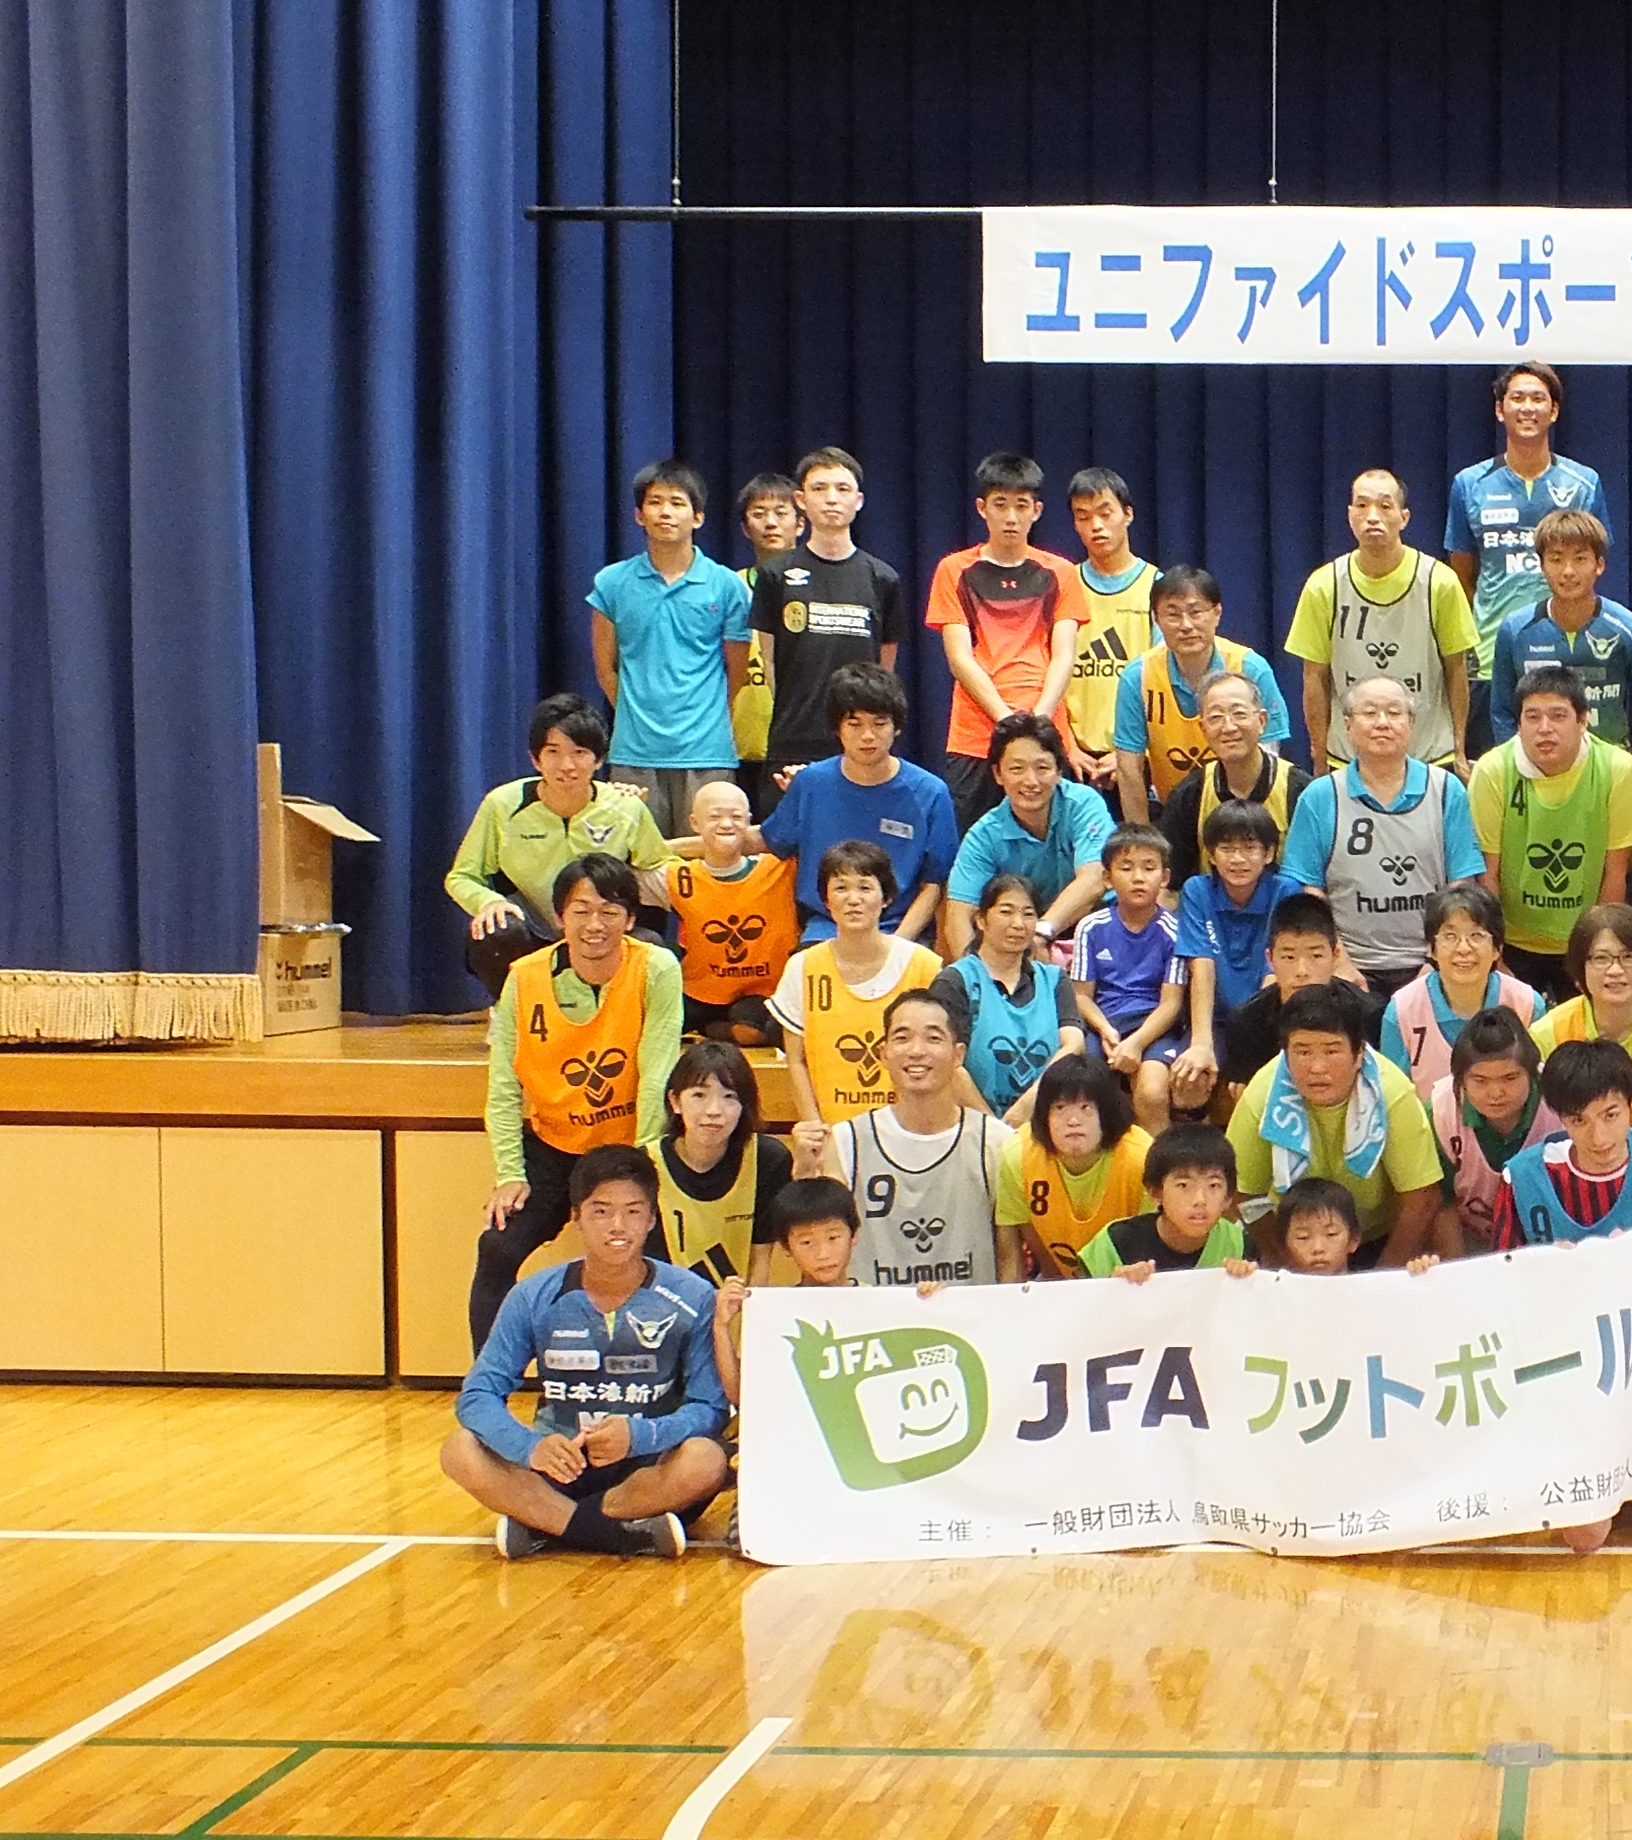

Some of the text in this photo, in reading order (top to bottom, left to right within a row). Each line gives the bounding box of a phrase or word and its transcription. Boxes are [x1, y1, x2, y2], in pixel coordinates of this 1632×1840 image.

[1340, 605, 1370, 640] 11
[1147, 689, 1165, 725] 11
[1510, 778, 1526, 817] 4
[1346, 817, 1375, 856] 8
[677, 865, 693, 899] 6
[806, 973, 832, 1013] 10
[529, 1003, 548, 1042] 4
[1412, 1026, 1427, 1067] 7
[865, 1173, 897, 1219] 9
[1030, 1180, 1050, 1217] 8
[673, 1209, 686, 1253] 1
[1530, 1204, 1554, 1244] 9
[873, 1250, 974, 1286] hummel
[818, 1337, 894, 1380] JFA
[1016, 1345, 1210, 1442] JFA
[1024, 1499, 1181, 1536] 一般財団法人
[1191, 1500, 1391, 1539] 鳥取県サッカー協会
